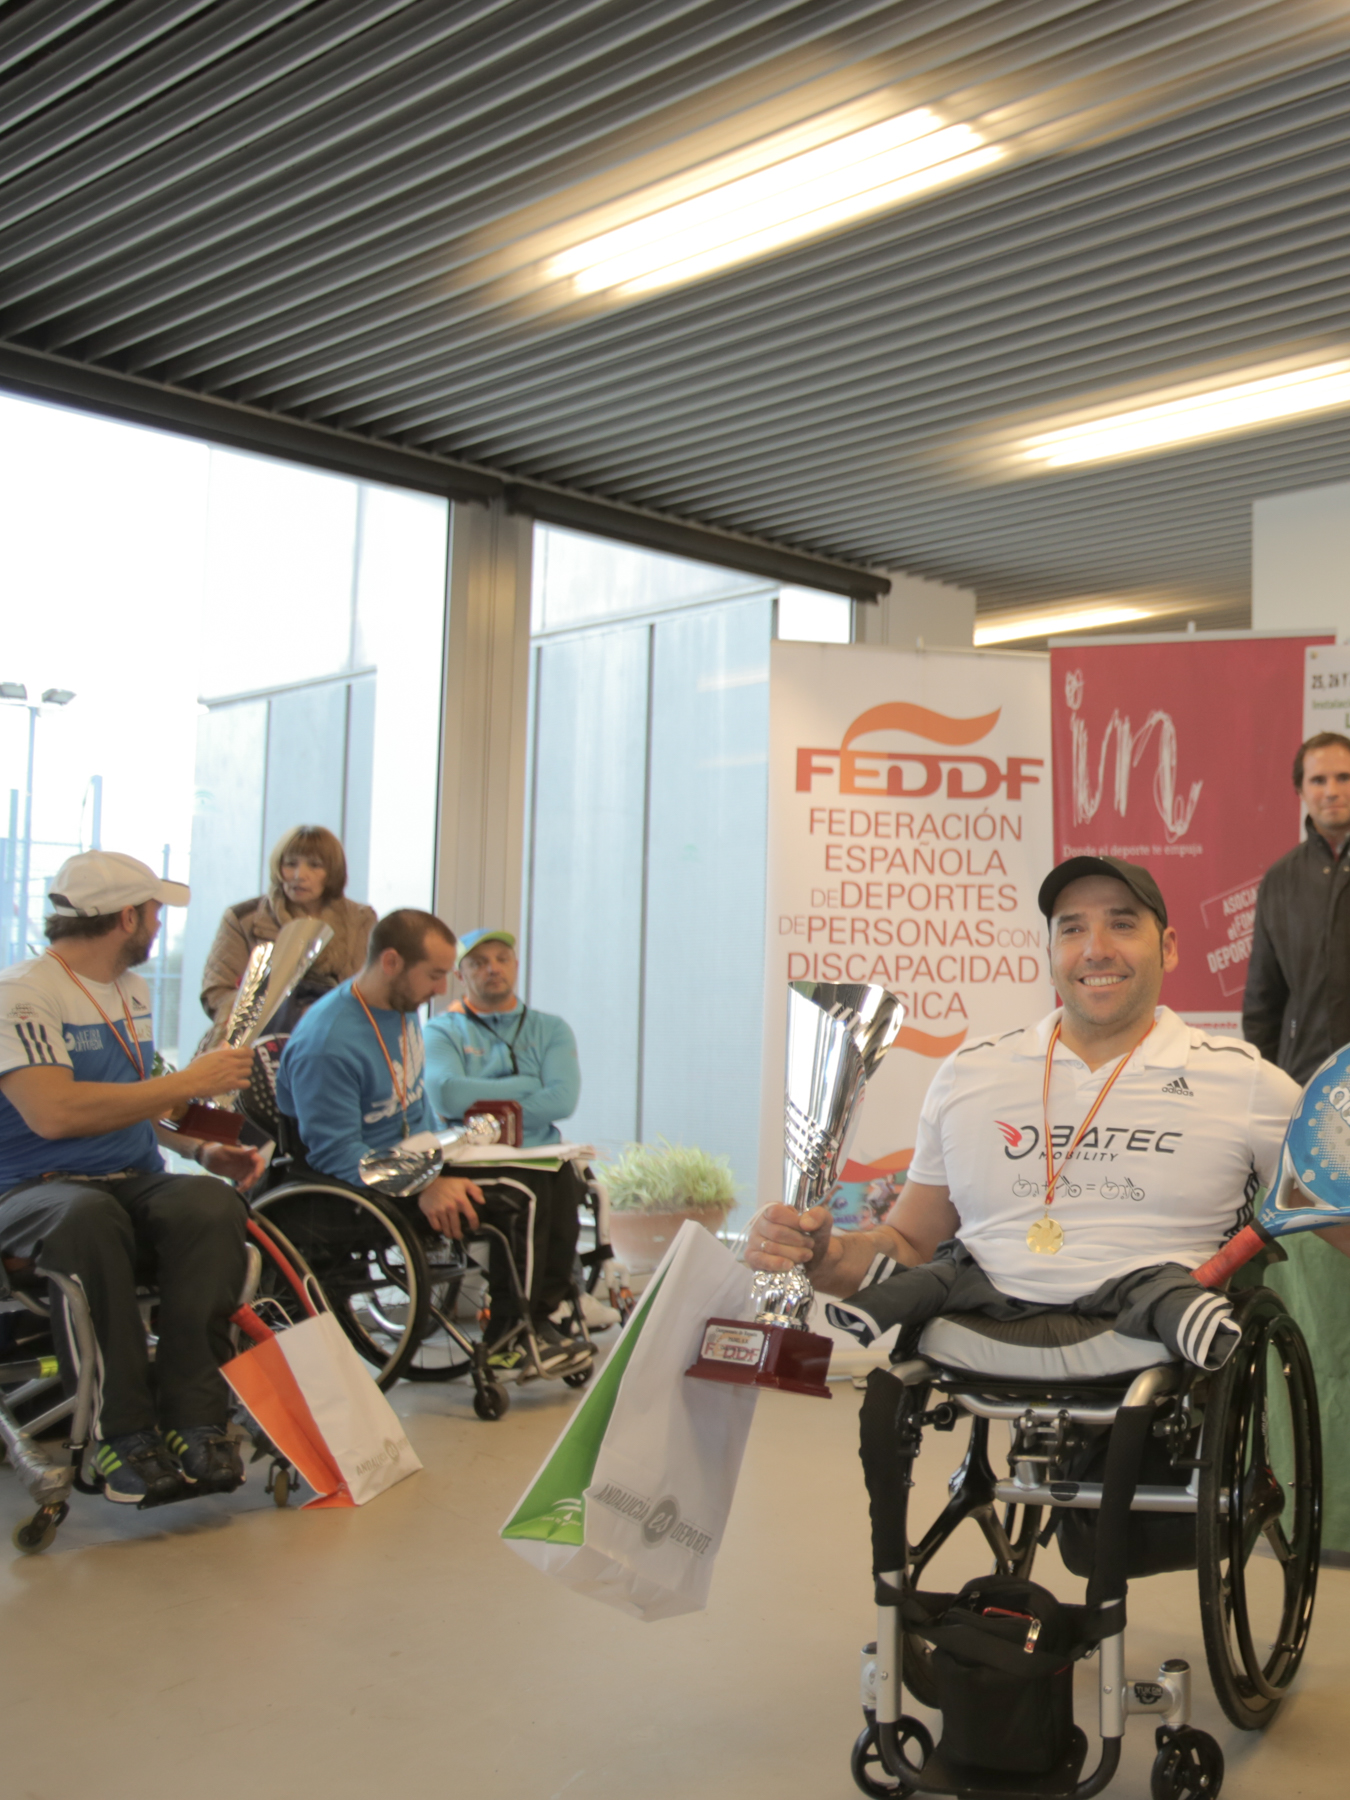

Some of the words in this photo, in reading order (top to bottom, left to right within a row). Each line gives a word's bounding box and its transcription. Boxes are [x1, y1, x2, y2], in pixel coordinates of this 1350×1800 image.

[1328, 673, 1339, 688] 26
[796, 747, 1044, 801] FEDDF
[809, 806, 1022, 842] FEDERACIÓN
[825, 841, 1008, 877] ESPAÑOLA
[1063, 844, 1097, 857] Donde
[1098, 844, 1109, 857] el
[1110, 844, 1150, 859] deporte
[1152, 845, 1162, 856] te
[1164, 843, 1204, 858] empuja
[787, 952, 1040, 984] DISCAPACIDAD
[896, 990, 969, 1020] SICA
[1162, 1086, 1194, 1097] adidas
[1047, 1125, 1183, 1154] BATEC
[1038, 1151, 1119, 1162] MOBILITY
[593, 1483, 651, 1522] ANDALUCÍA
[669, 1522, 713, 1555] DEPORTE
